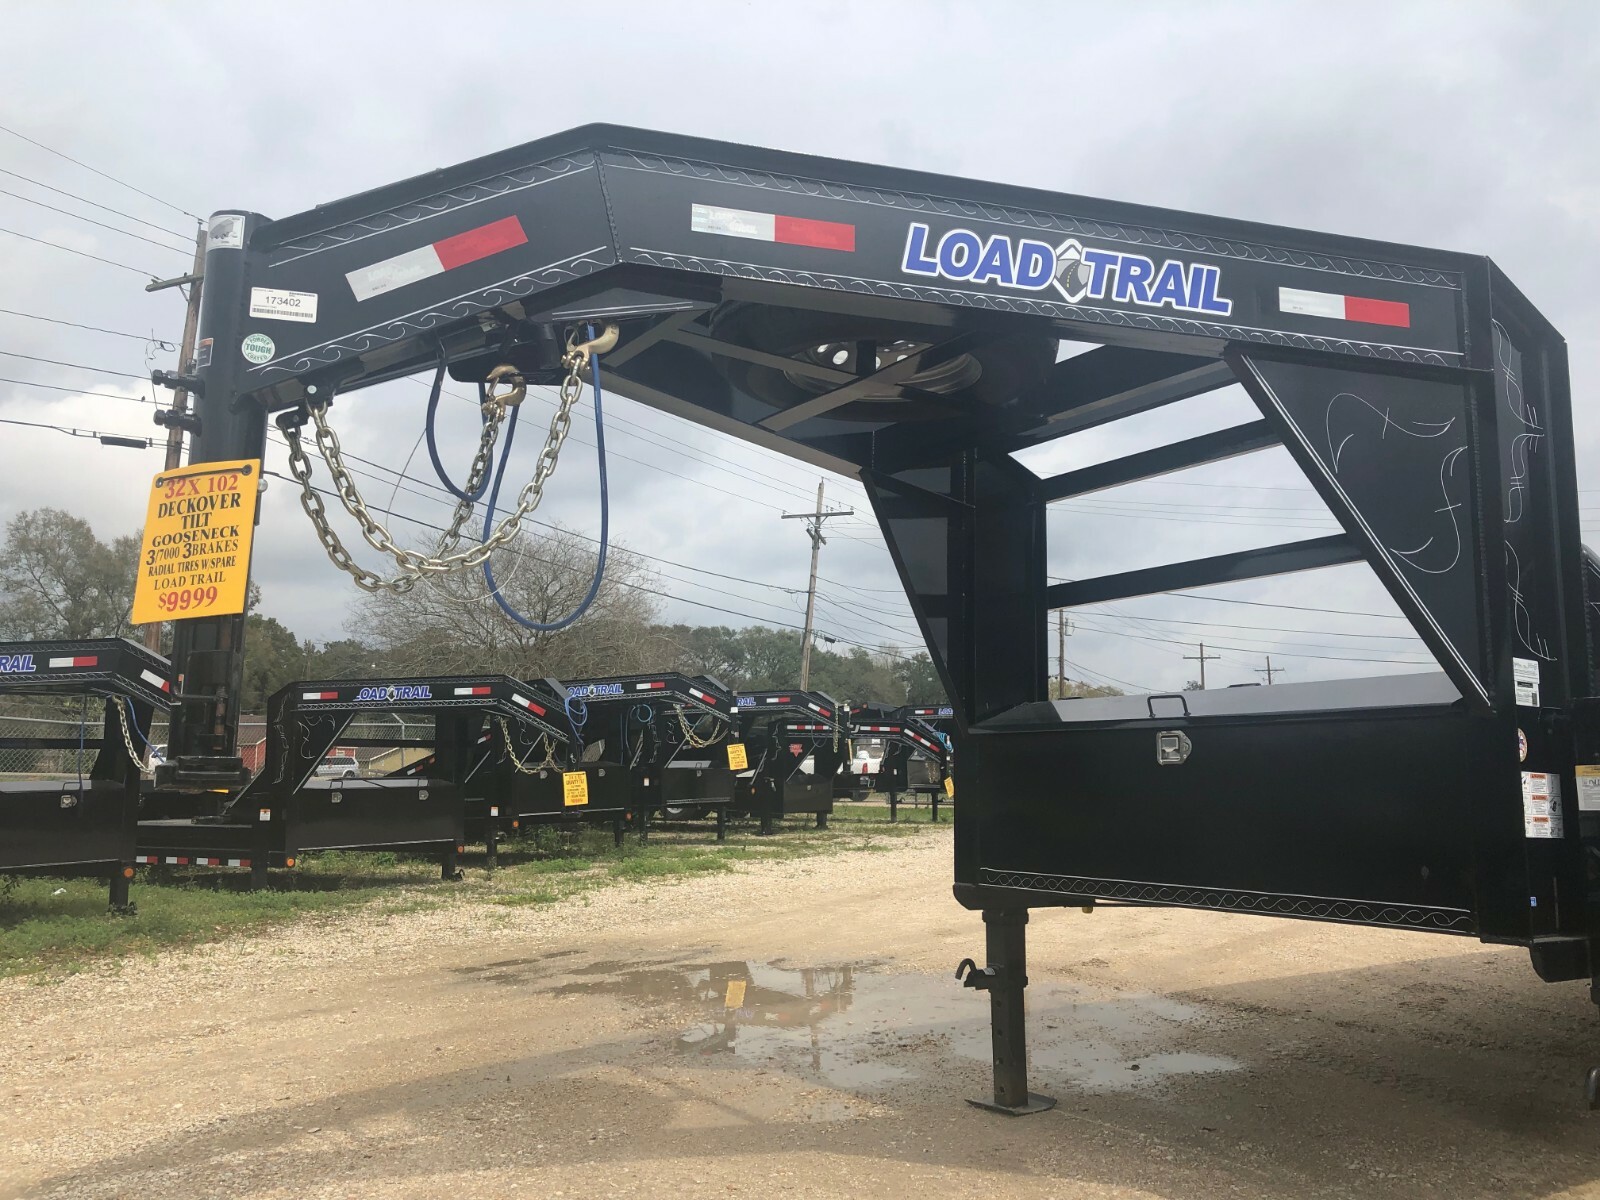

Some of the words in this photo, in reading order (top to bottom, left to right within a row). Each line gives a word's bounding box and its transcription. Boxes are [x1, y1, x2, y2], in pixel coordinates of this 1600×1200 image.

[902, 222, 1057, 290] LOAD
[1081, 247, 1234, 316] TRAIL
[265, 296, 301, 307] 173402
[246, 344, 272, 354] TOUGH
[207, 474, 238, 493] 102
[158, 493, 241, 518] DECKOVER
[181, 512, 212, 529] TILT
[152, 525, 239, 548] GOOSENECK
[148, 564, 175, 577] RADIAL
[178, 559, 199, 572] TIRES
[154, 575, 186, 590] LOAD
[190, 571, 226, 586] TRAIL
[158, 586, 218, 612] $9999
[394, 686, 432, 699] TRAIL
[594, 683, 624, 695] TRAIL
